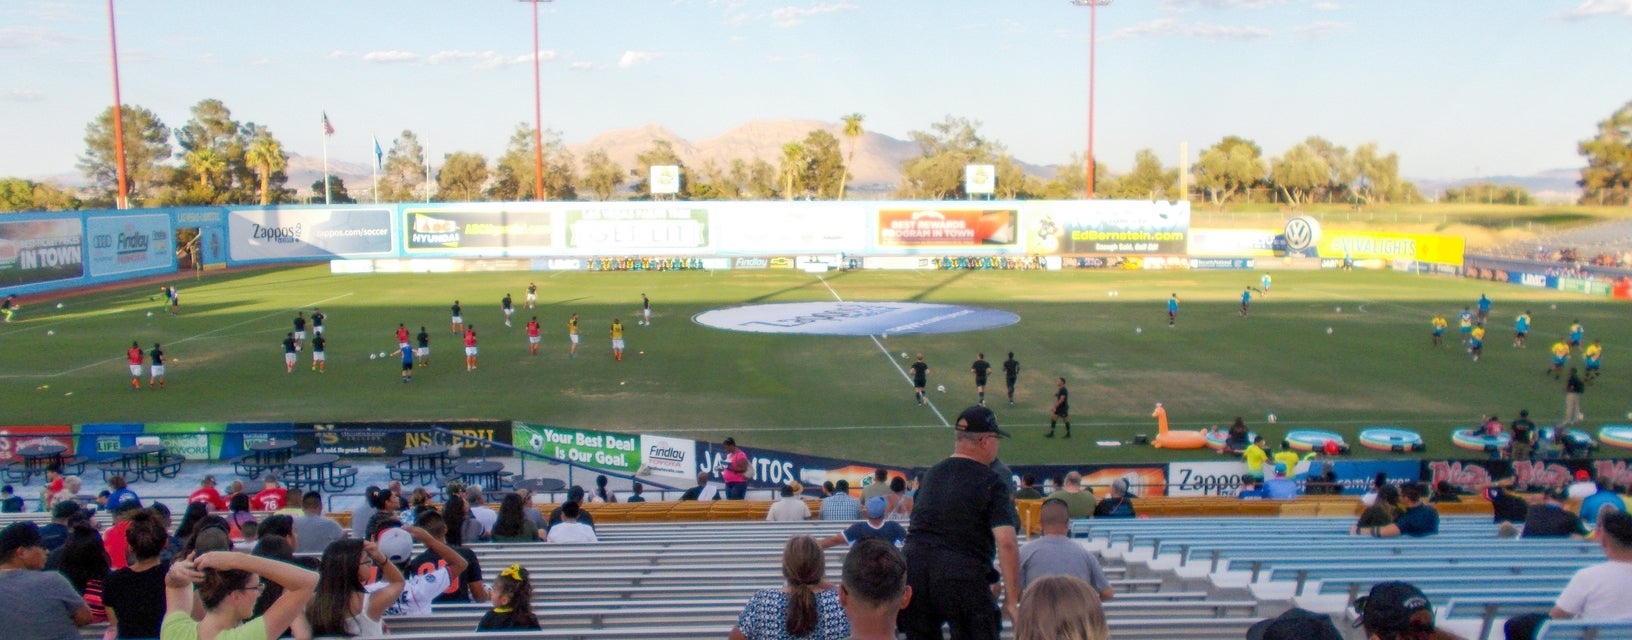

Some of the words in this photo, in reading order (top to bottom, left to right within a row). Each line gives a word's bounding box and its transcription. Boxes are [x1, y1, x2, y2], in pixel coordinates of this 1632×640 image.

[117, 231, 149, 251] Findlay
[252, 223, 295, 242] Zappos
[413, 233, 460, 243] HYUNDAI
[883, 229, 929, 238] OGRAM
[944, 229, 975, 238] TOWN
[1072, 230, 1184, 241] EdBernstein.com
[20, 249, 38, 269] IN
[38, 246, 82, 268] TOWN
[1521, 273, 1547, 287] UMC
[405, 429, 494, 449] NSC.EDU
[544, 428, 574, 445] Your
[575, 432, 603, 448] Best
[605, 435, 635, 452] Deal
[555, 446, 566, 460] Is
[568, 448, 593, 463] Our
[595, 451, 629, 467] Goal.
[650, 445, 685, 462] Findlay
[700, 450, 796, 486] JAITOS
[1179, 469, 1250, 496] Zappo
[262, 500, 278, 511] 76
